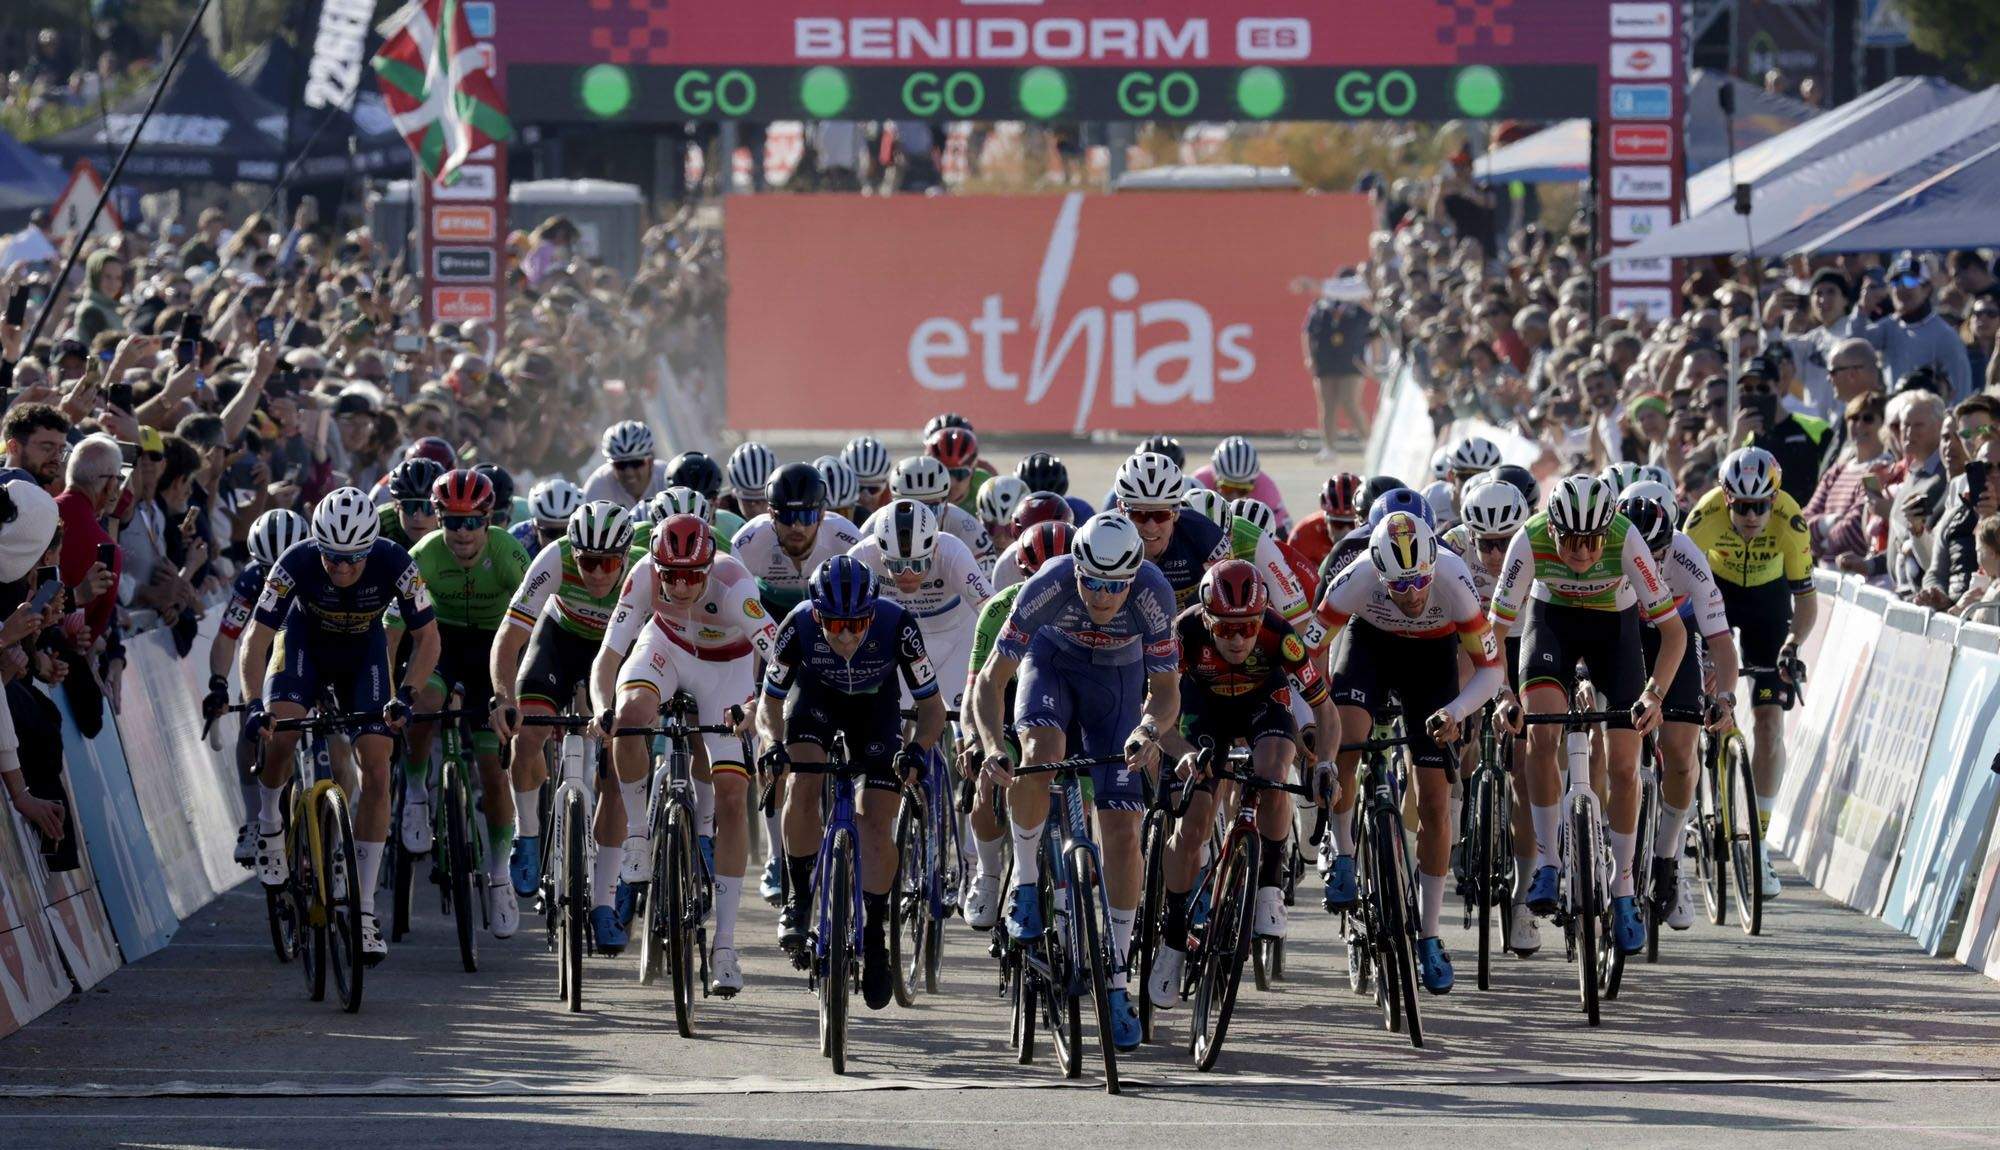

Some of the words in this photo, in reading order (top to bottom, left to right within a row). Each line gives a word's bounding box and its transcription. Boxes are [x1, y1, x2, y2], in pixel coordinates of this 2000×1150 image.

[795, 17, 1209, 59] BENIDORM
[674, 71, 757, 116] GO
[902, 71, 985, 116] GO
[1117, 71, 1200, 116] GO
[1335, 70, 1418, 116] GO
[908, 192, 1256, 434] ethias
[526, 571, 551, 598] crelan
[1267, 561, 1294, 596] corendon
[1505, 558, 1523, 588] crelan
[1634, 556, 1659, 592] corendon
[230, 606, 247, 622] 45
[616, 611, 627, 624] 8
[757, 637, 769, 651] 8
[1305, 624, 1323, 644] 23
[1284, 638, 1302, 659] CIBEL
[919, 664, 931, 679] 2
